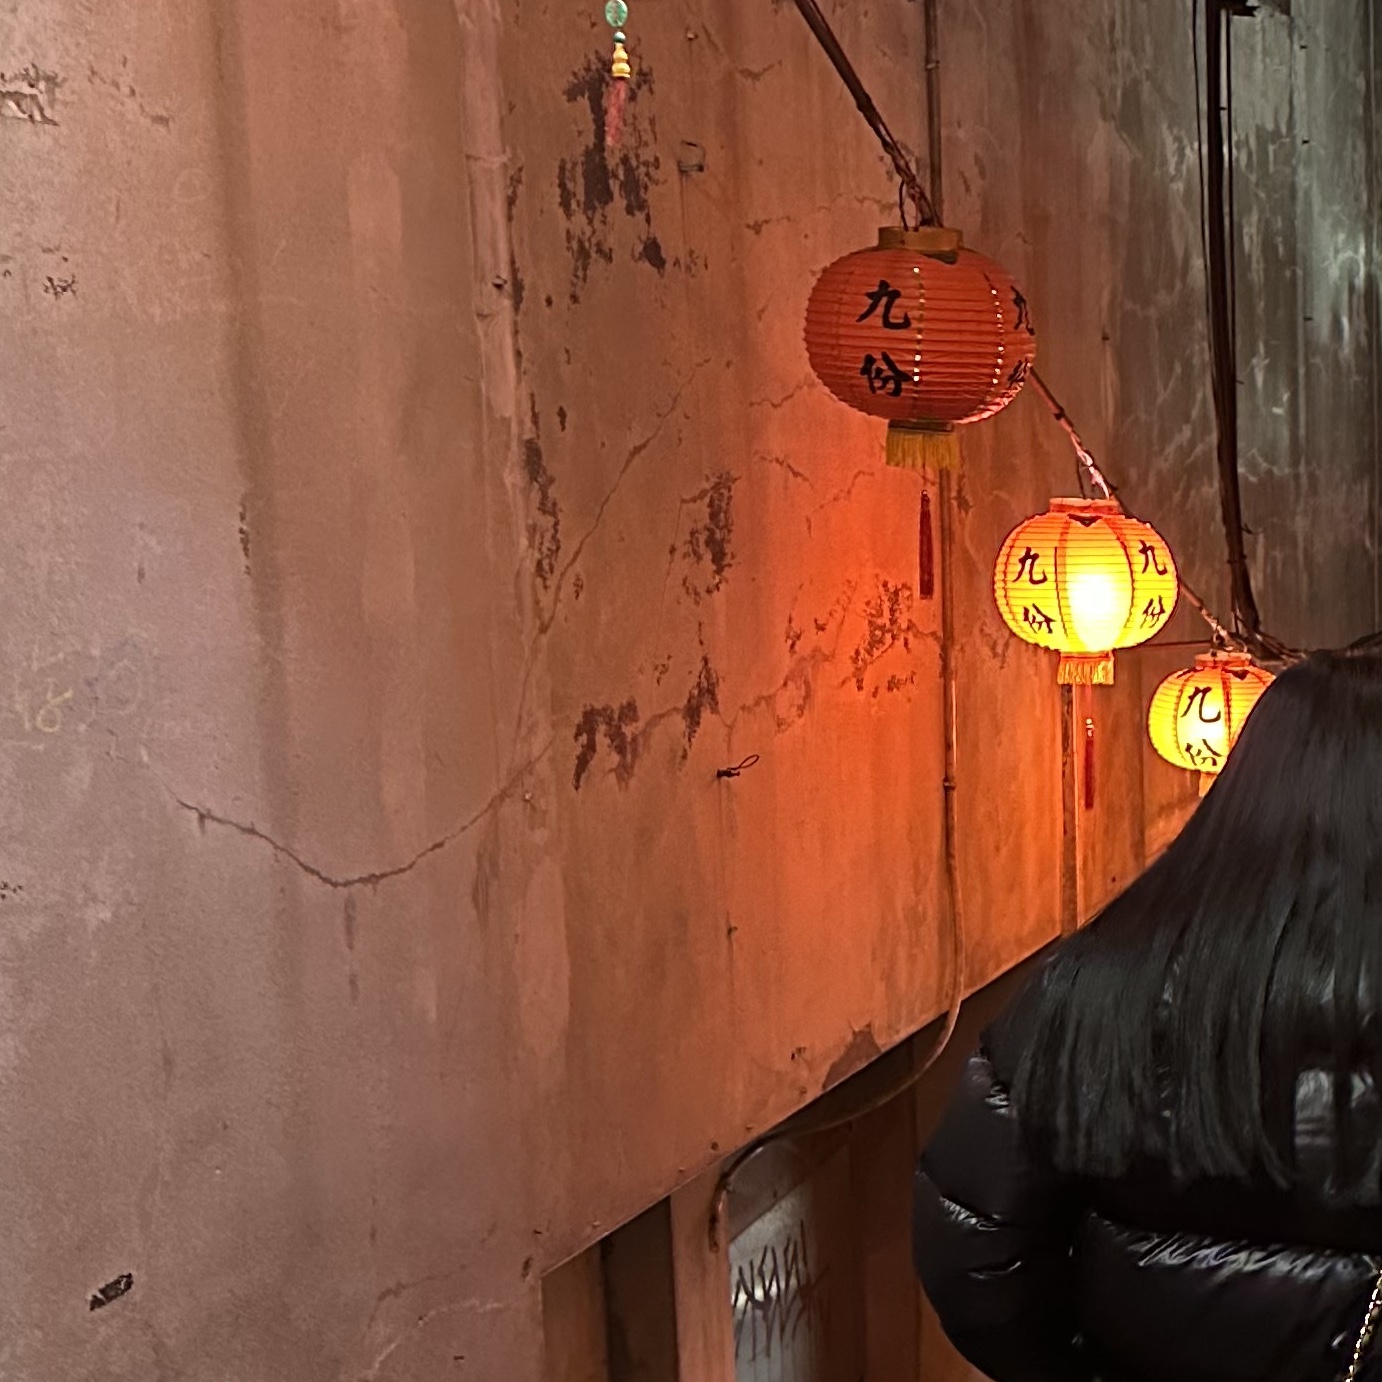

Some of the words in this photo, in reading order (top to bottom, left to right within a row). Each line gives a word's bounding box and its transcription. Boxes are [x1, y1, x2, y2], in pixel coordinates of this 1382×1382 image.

[856, 279, 914, 398] 九份
[1011, 546, 1057, 634] 九份
[1138, 539, 1168, 629] 九份
[1181, 686, 1222, 767] 九份
